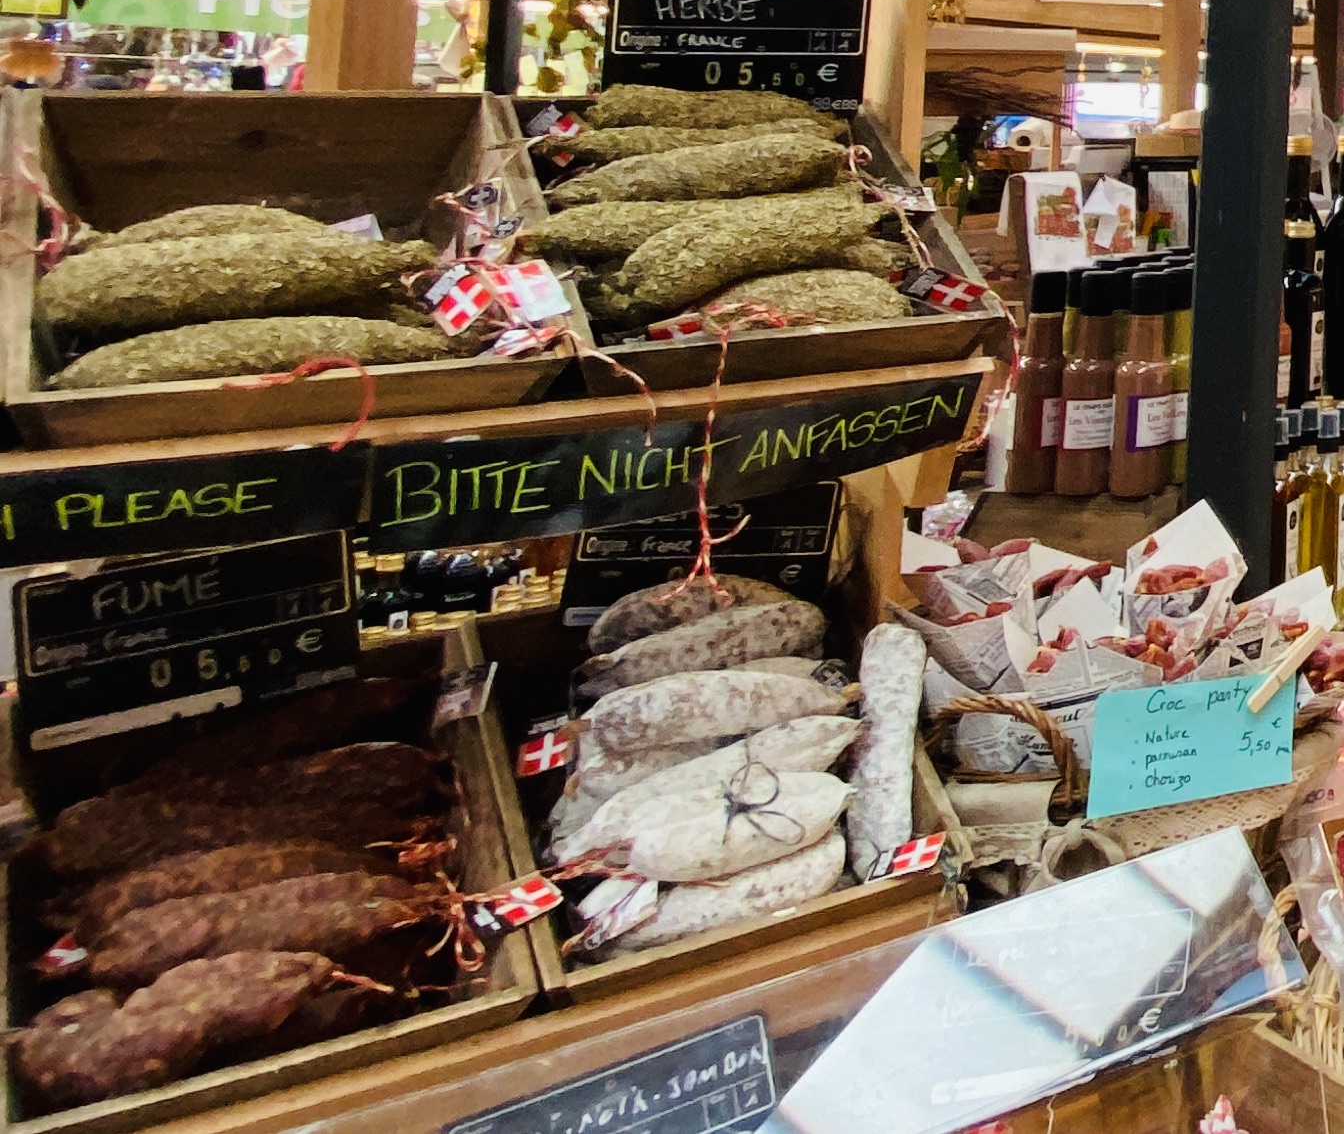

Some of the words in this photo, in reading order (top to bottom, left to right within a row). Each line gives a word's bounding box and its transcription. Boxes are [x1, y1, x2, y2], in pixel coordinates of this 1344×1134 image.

[677, 33, 747, 50] FRANCE
[816, 63, 839, 82] €
[56, 477, 278, 531] PLEASE
[380, 459, 562, 529] BITTE
[578, 436, 742, 501] NICHT
[739, 386, 966, 473] ANFASSEN
[92, 554, 221, 620] FUMÉ
[297, 628, 324, 654] €
[1146, 688, 1187, 715] Croc
[1145, 724, 1191, 744] Nature
[1138, 1007, 1162, 1035] €
